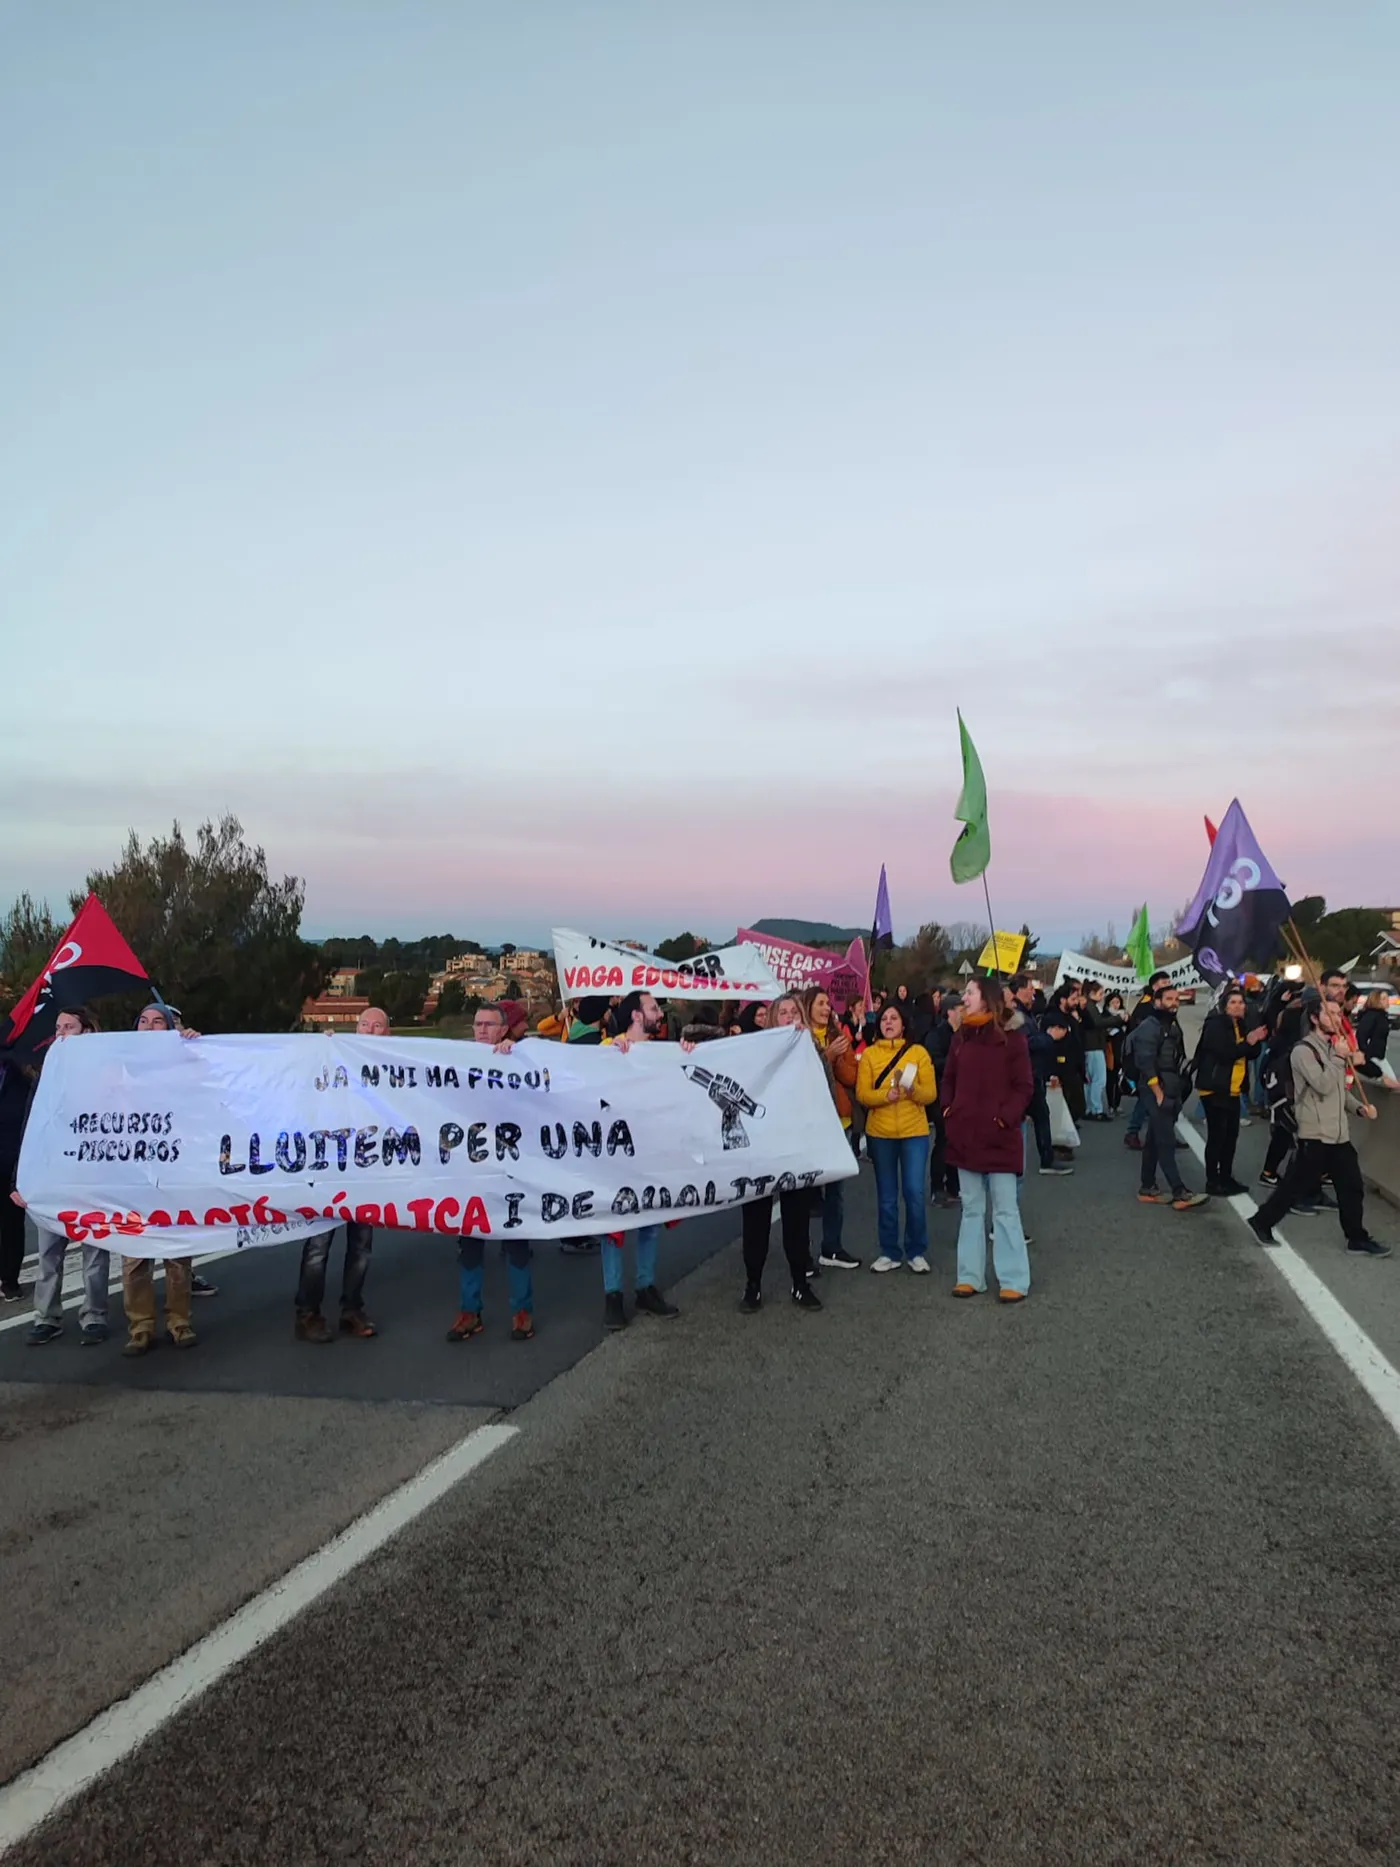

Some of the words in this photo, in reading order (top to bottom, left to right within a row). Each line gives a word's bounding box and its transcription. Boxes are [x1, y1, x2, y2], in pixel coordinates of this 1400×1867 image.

[564, 964, 624, 989] VAGA
[314, 1065, 349, 1091] JA
[361, 1064, 418, 1089] N'HI
[425, 1065, 460, 1089] HA
[468, 1067, 551, 1092] PROU!
[219, 1125, 421, 1175] LLUITEM
[439, 1121, 522, 1165] PER
[540, 1119, 635, 1160] UNA
[503, 1192, 526, 1229] I
[540, 1190, 595, 1222] DE
